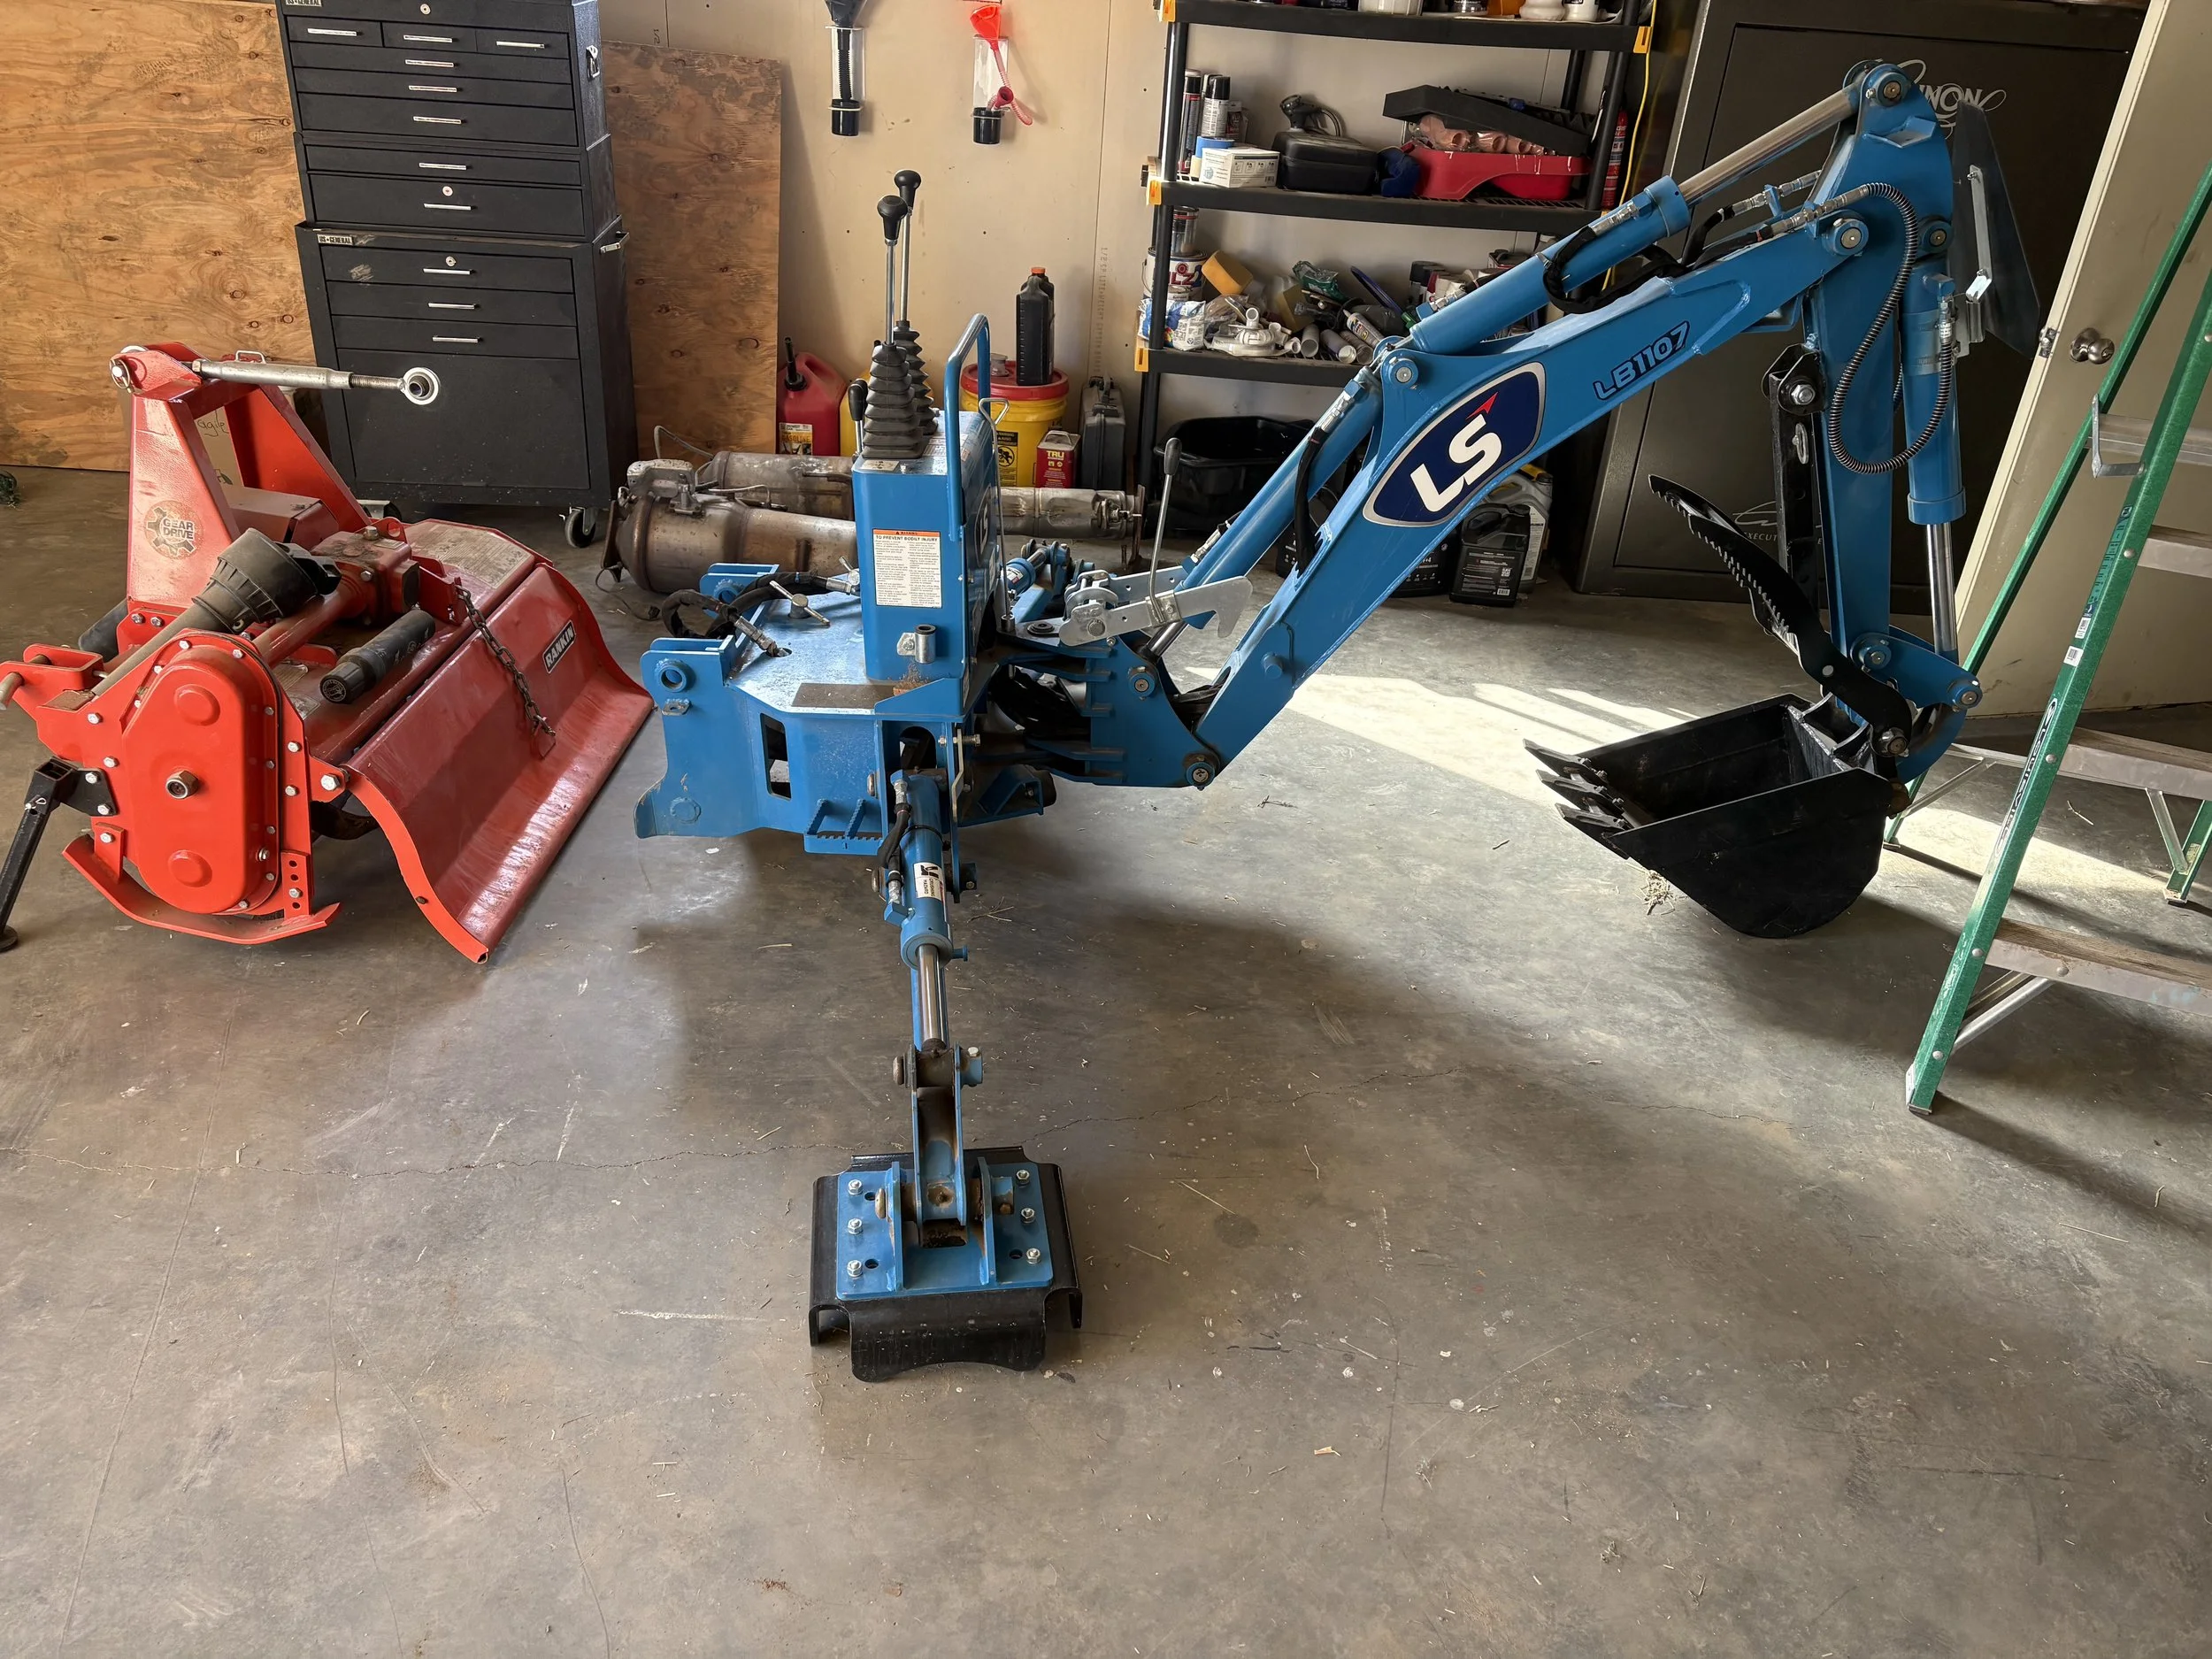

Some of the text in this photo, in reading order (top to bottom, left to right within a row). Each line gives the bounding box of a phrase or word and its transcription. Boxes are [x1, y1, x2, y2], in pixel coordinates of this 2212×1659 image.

[1594, 320, 1689, 400] LB1107
[1410, 413, 1502, 512] LS
[163, 518, 194, 531] GEAR
[163, 526, 194, 540] DRIVE
[545, 626, 574, 668] RANKIN
